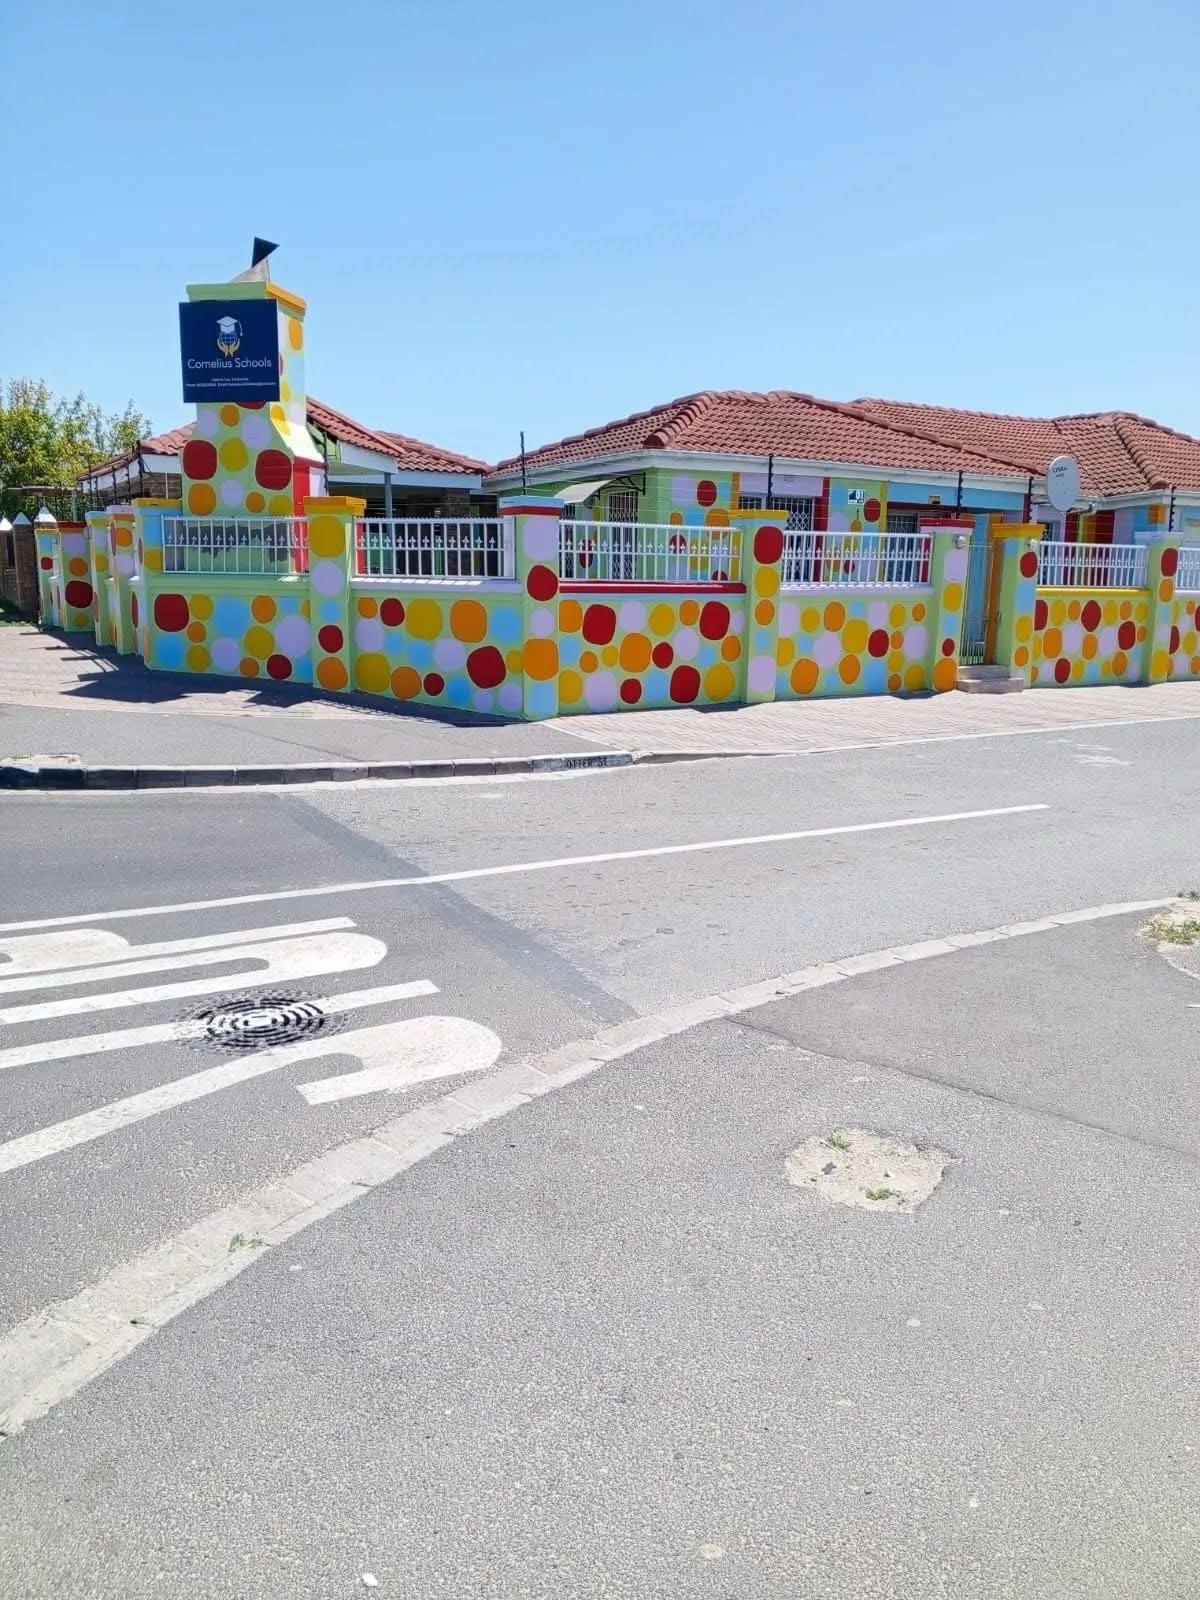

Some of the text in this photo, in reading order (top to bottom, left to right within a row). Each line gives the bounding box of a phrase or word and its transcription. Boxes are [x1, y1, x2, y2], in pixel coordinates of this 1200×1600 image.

[187, 356, 272, 369] Cornelius Schools
[566, 758, 593, 769] OTTER
